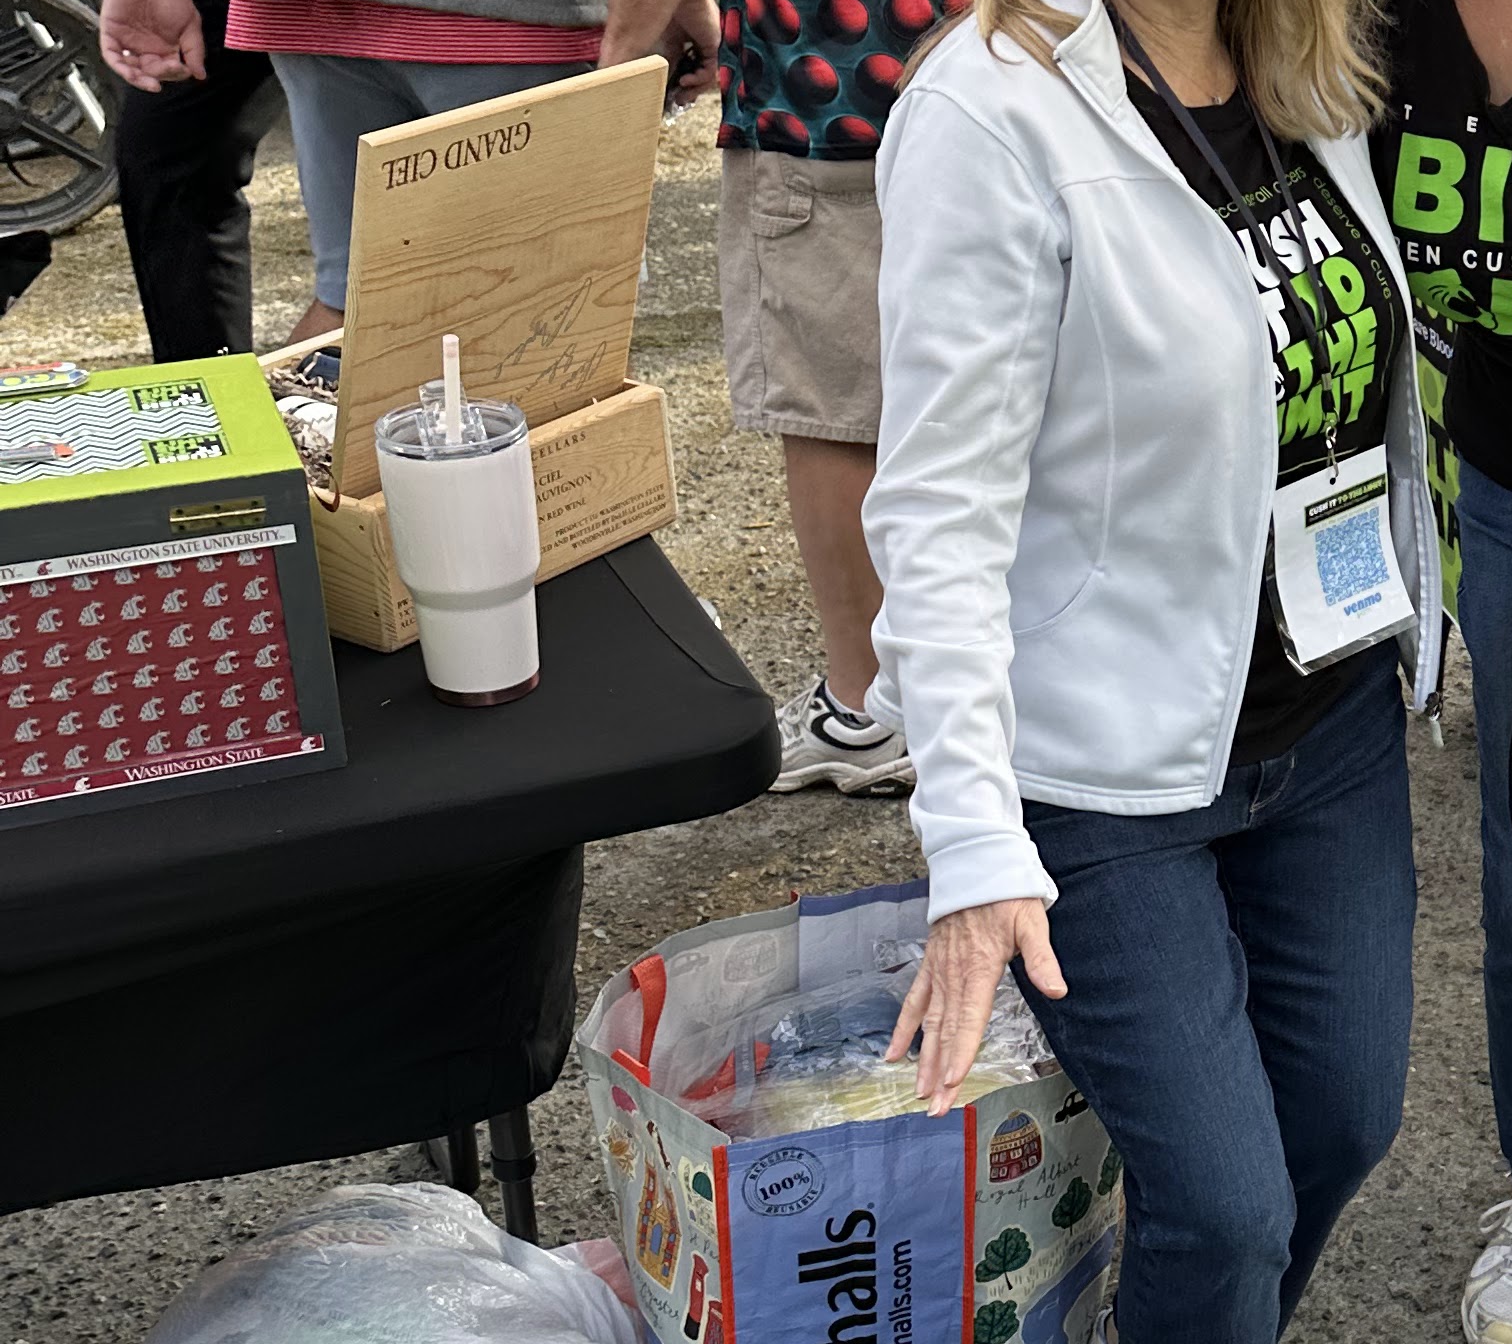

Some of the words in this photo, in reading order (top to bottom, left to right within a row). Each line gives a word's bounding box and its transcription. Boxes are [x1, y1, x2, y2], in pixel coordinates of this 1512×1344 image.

[444, 122, 532, 170] GRAND
[382, 148, 437, 190] CIEL
[1237, 199, 1343, 289] USH
[1314, 176, 1360, 239] deserve
[1361, 243, 1371, 255] a
[1371, 259, 1391, 299] cure
[1396, 239, 1440, 265] EN
[1259, 288, 1290, 353] T
[1282, 307, 1377, 394] THE
[1429, 328, 1454, 359] Bloo
[536, 472, 593, 505] AUVIGNON
[66, 545, 160, 571] WASHINGTON
[162, 539, 201, 557] STATE
[203, 529, 280, 552] UNIVERSITY
[1344, 592, 1382, 616] venmo
[125, 753, 224, 781] WASHINGTON
[225, 746, 265, 765] STATE
[759, 1170, 810, 1201] 100%
